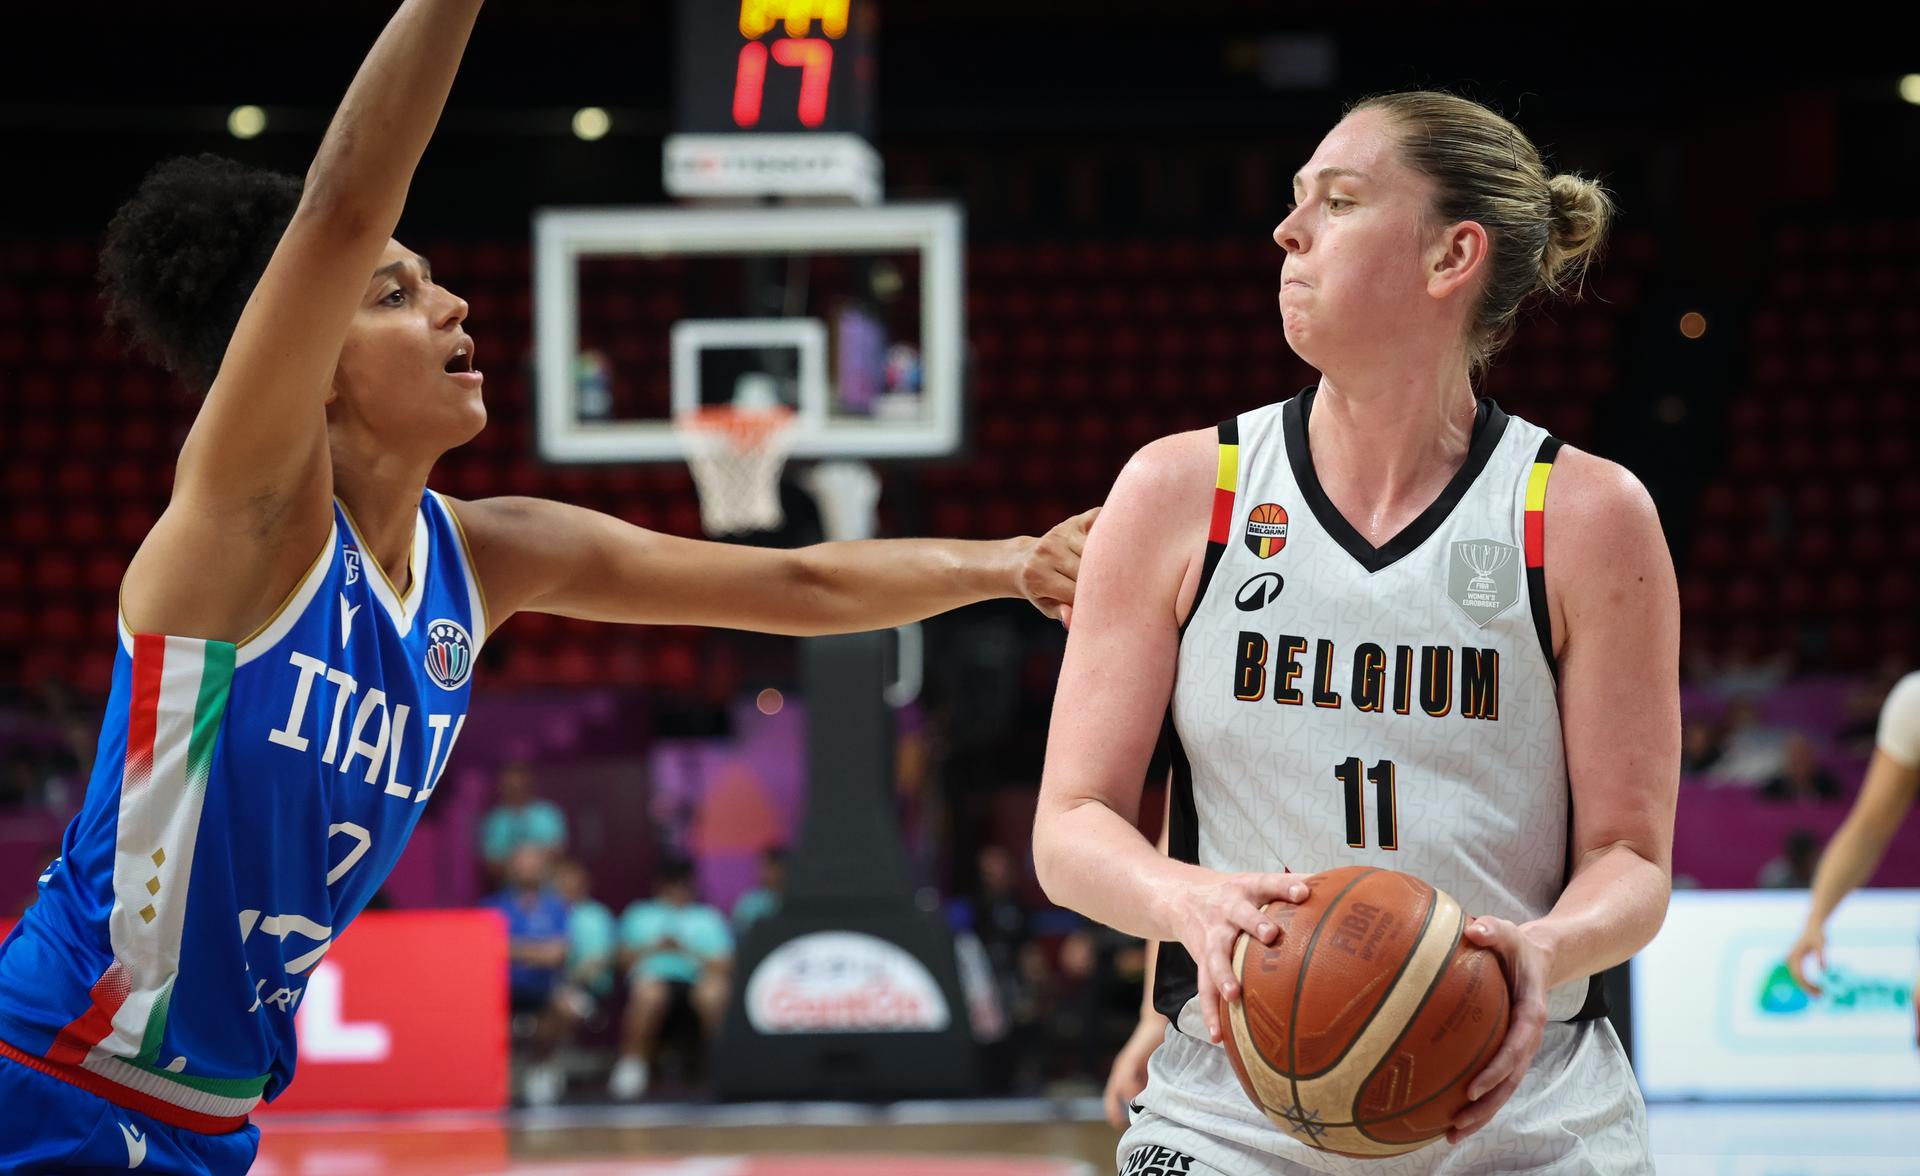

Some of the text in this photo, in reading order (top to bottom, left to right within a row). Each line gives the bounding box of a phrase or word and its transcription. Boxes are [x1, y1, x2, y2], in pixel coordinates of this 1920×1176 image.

[732, 38, 833, 128] 17
[1249, 527, 1286, 535] BELGIUM
[1234, 630, 1500, 722] BELGIUM
[1334, 756, 1399, 851] 11
[1330, 901, 1380, 956] FIBA
